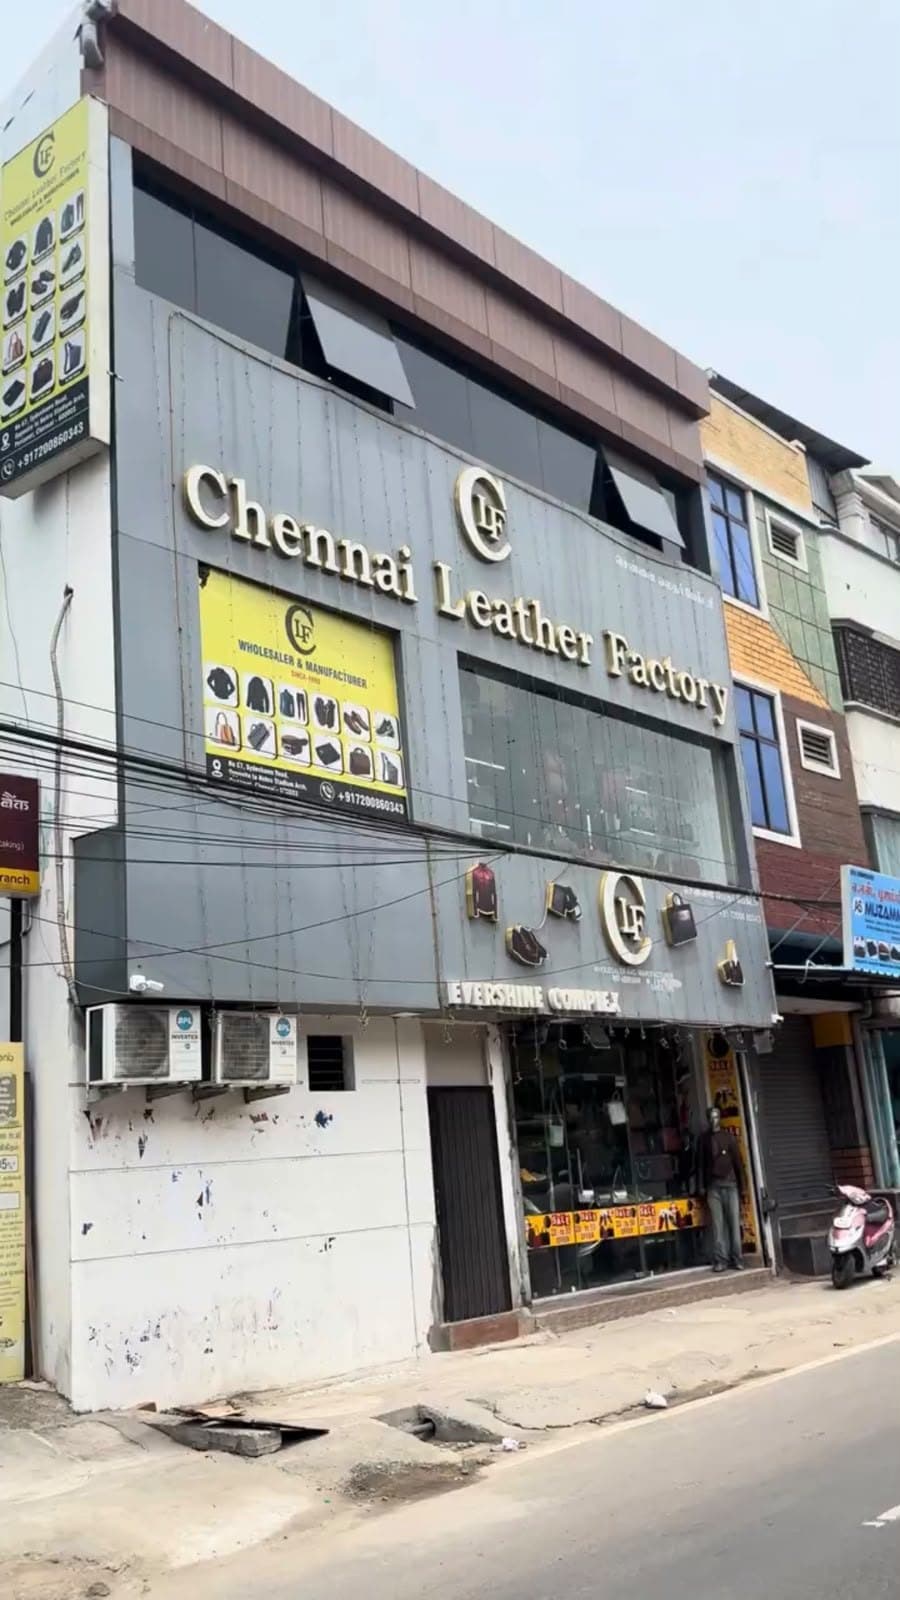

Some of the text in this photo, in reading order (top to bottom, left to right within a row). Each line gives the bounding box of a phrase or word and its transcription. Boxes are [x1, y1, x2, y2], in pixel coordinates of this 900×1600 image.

[184, 465, 418, 604] Chennai
[433, 560, 593, 666] Leather
[603, 629, 729, 726] Factory
[238, 639, 367, 689] WHOLESALER & MANUFACTURER
[1, 791, 29, 812] बैंक
[447, 981, 621, 1012] EVERSHINE COMPLEX
